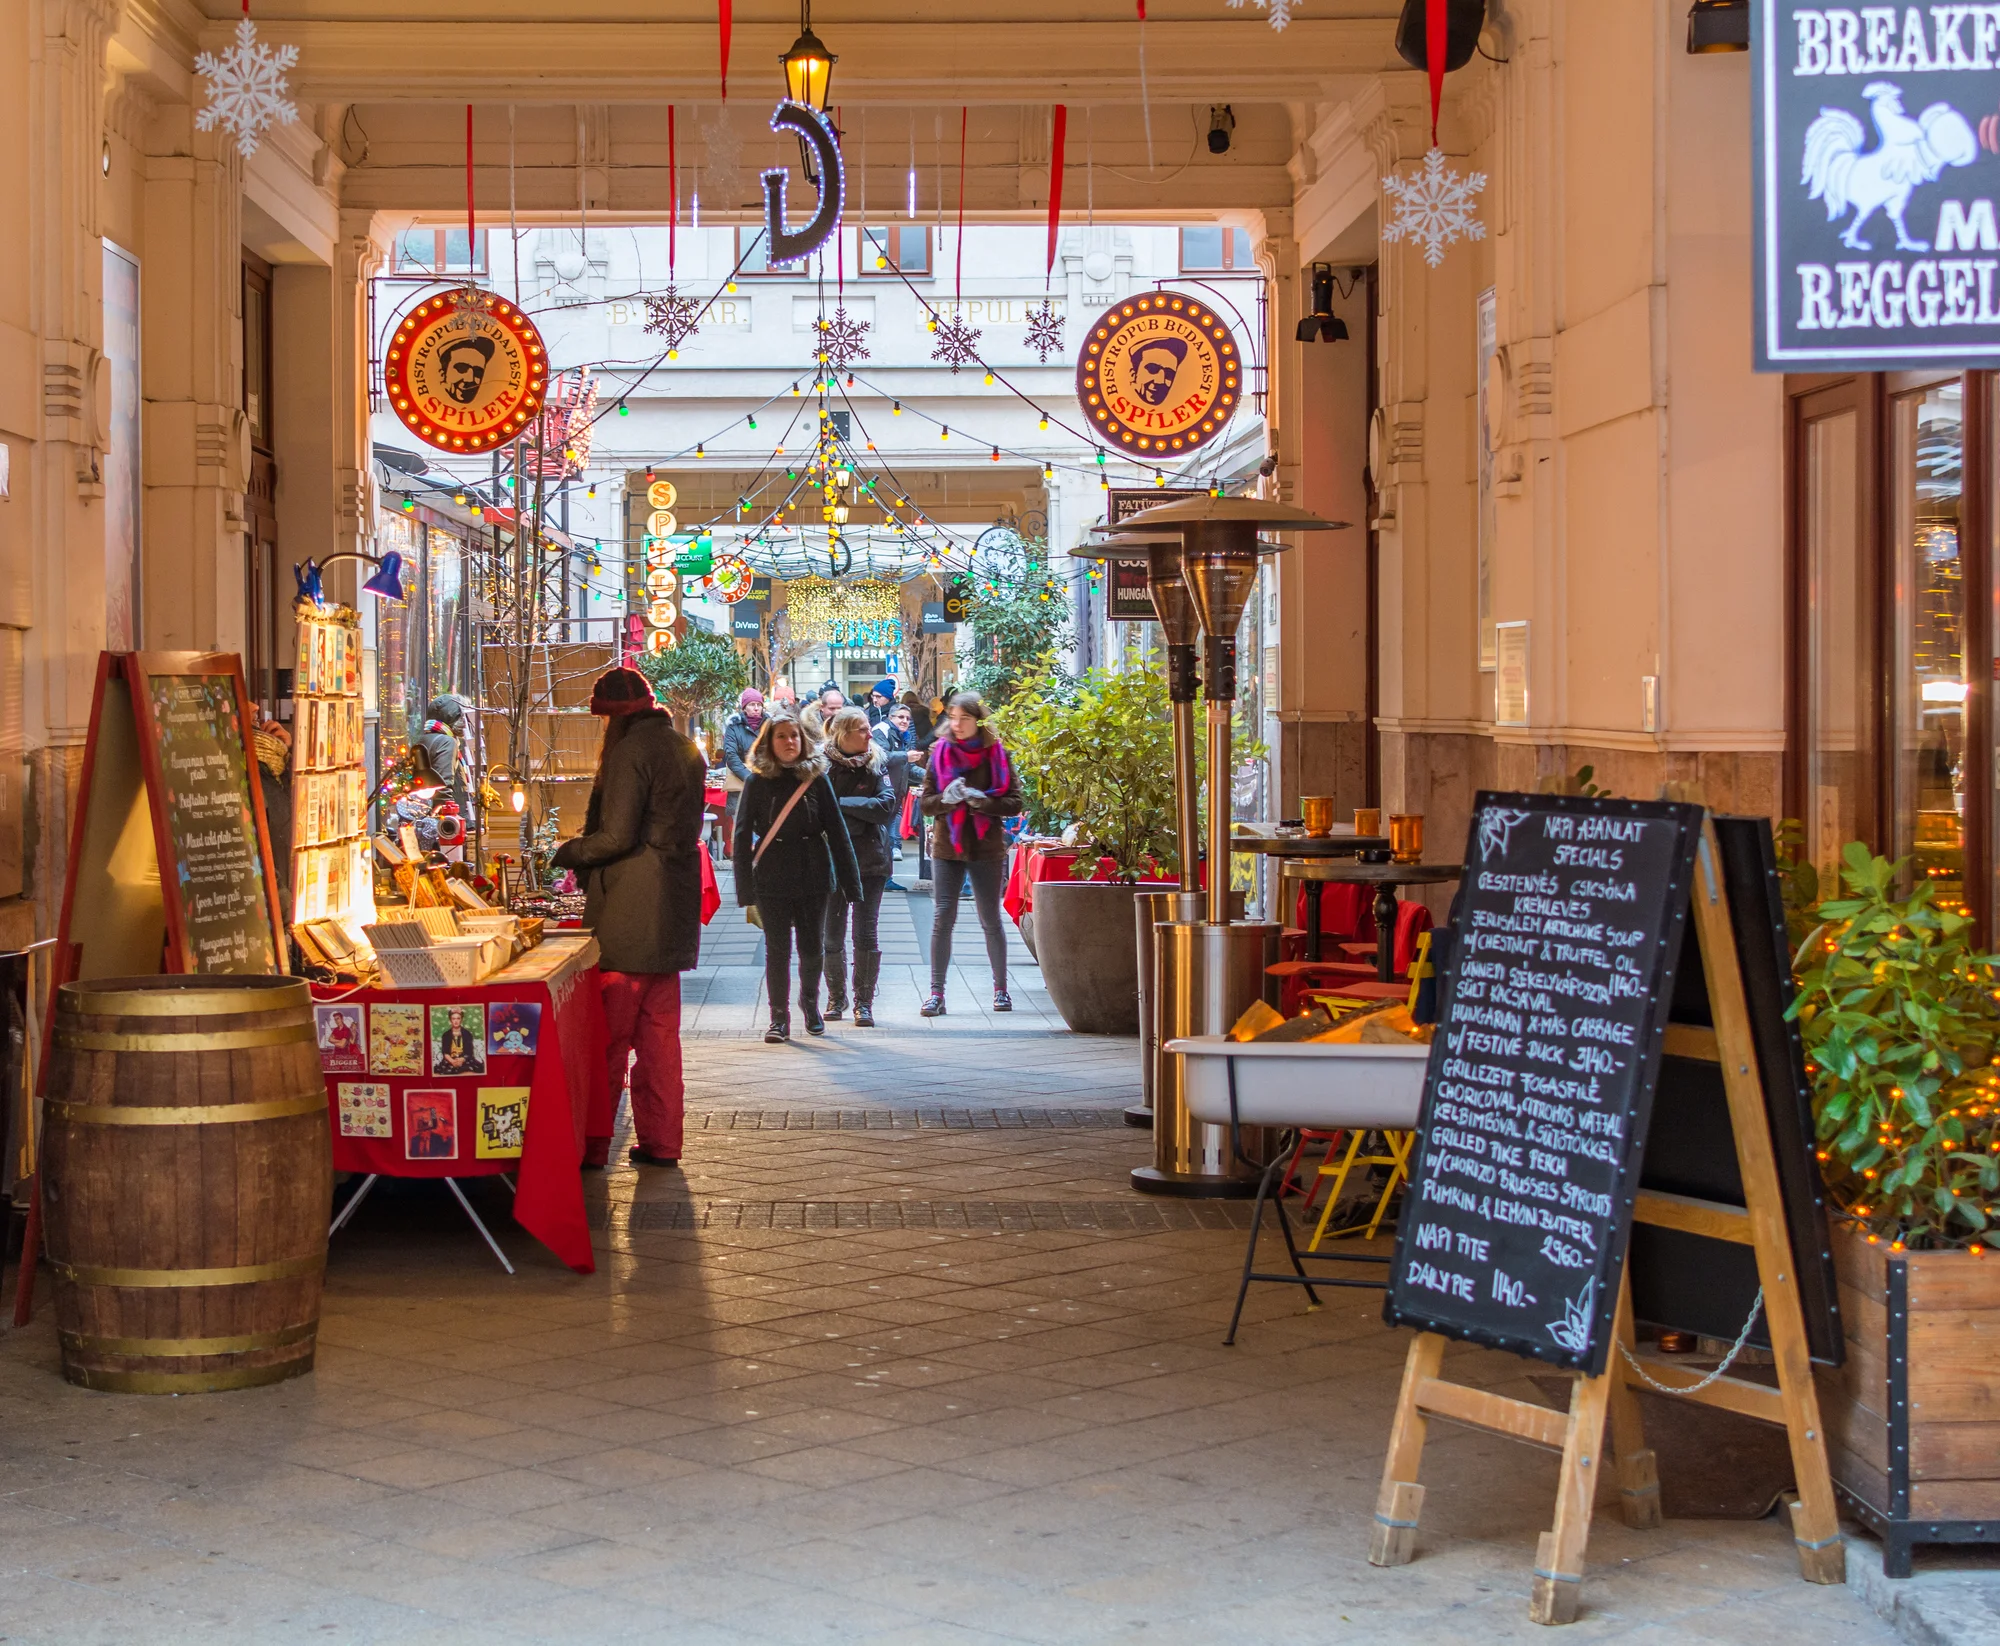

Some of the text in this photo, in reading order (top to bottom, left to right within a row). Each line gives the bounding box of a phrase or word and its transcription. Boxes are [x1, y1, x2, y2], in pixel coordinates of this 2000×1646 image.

[1934, 199, 2000, 252] M
[1104, 318, 1214, 396] BISTROPUB BUDAPEST
[424, 389, 517, 427] SPÍLER
[1111, 393, 1208, 429] SPÍLER
[735, 620, 759, 630] DiVino
[171, 752, 205, 772] Hungarian
[190, 769, 207, 785] plate
[211, 790, 241, 807] Hungarian
[205, 830, 216, 845] cold
[217, 830, 232, 849] plate
[1543, 815, 1647, 843] NAPI AJÁNLAT
[1553, 845, 1624, 870] SPECIALS
[1478, 869, 1559, 895] GESZTENYÉS
[200, 934, 233, 953] Hungarian
[1471, 910, 1645, 947] JERUSALEM ARTICHOKE SOUP
[1540, 941, 1552, 960] &
[1554, 943, 1611, 969] TRUFFEL
[1615, 955, 1642, 975] OIL
[1456, 981, 1557, 1014] SÜLT KACSÁVAL
[1451, 1004, 1523, 1035] HUNGARIAN
[1571, 1017, 1636, 1045] CABBAGE
[1526, 1040, 1565, 1065] DUCK
[1442, 1058, 1516, 1088] GRILLEZETT
[1431, 1126, 1568, 1177] GRILLED PIKE PERCH
[1498, 1168, 1559, 1200] BRUSSELS
[1560, 1182, 1612, 1217] SPROUTS
[1422, 1178, 1477, 1213] PUMKIN
[1477, 1196, 1491, 1221] &
[1538, 1209, 1598, 1250] BUTTER
[1415, 1223, 1491, 1261] NAPI PITE
[1406, 1261, 1450, 1291] DAILY
[1450, 1273, 1475, 1302] PIE
